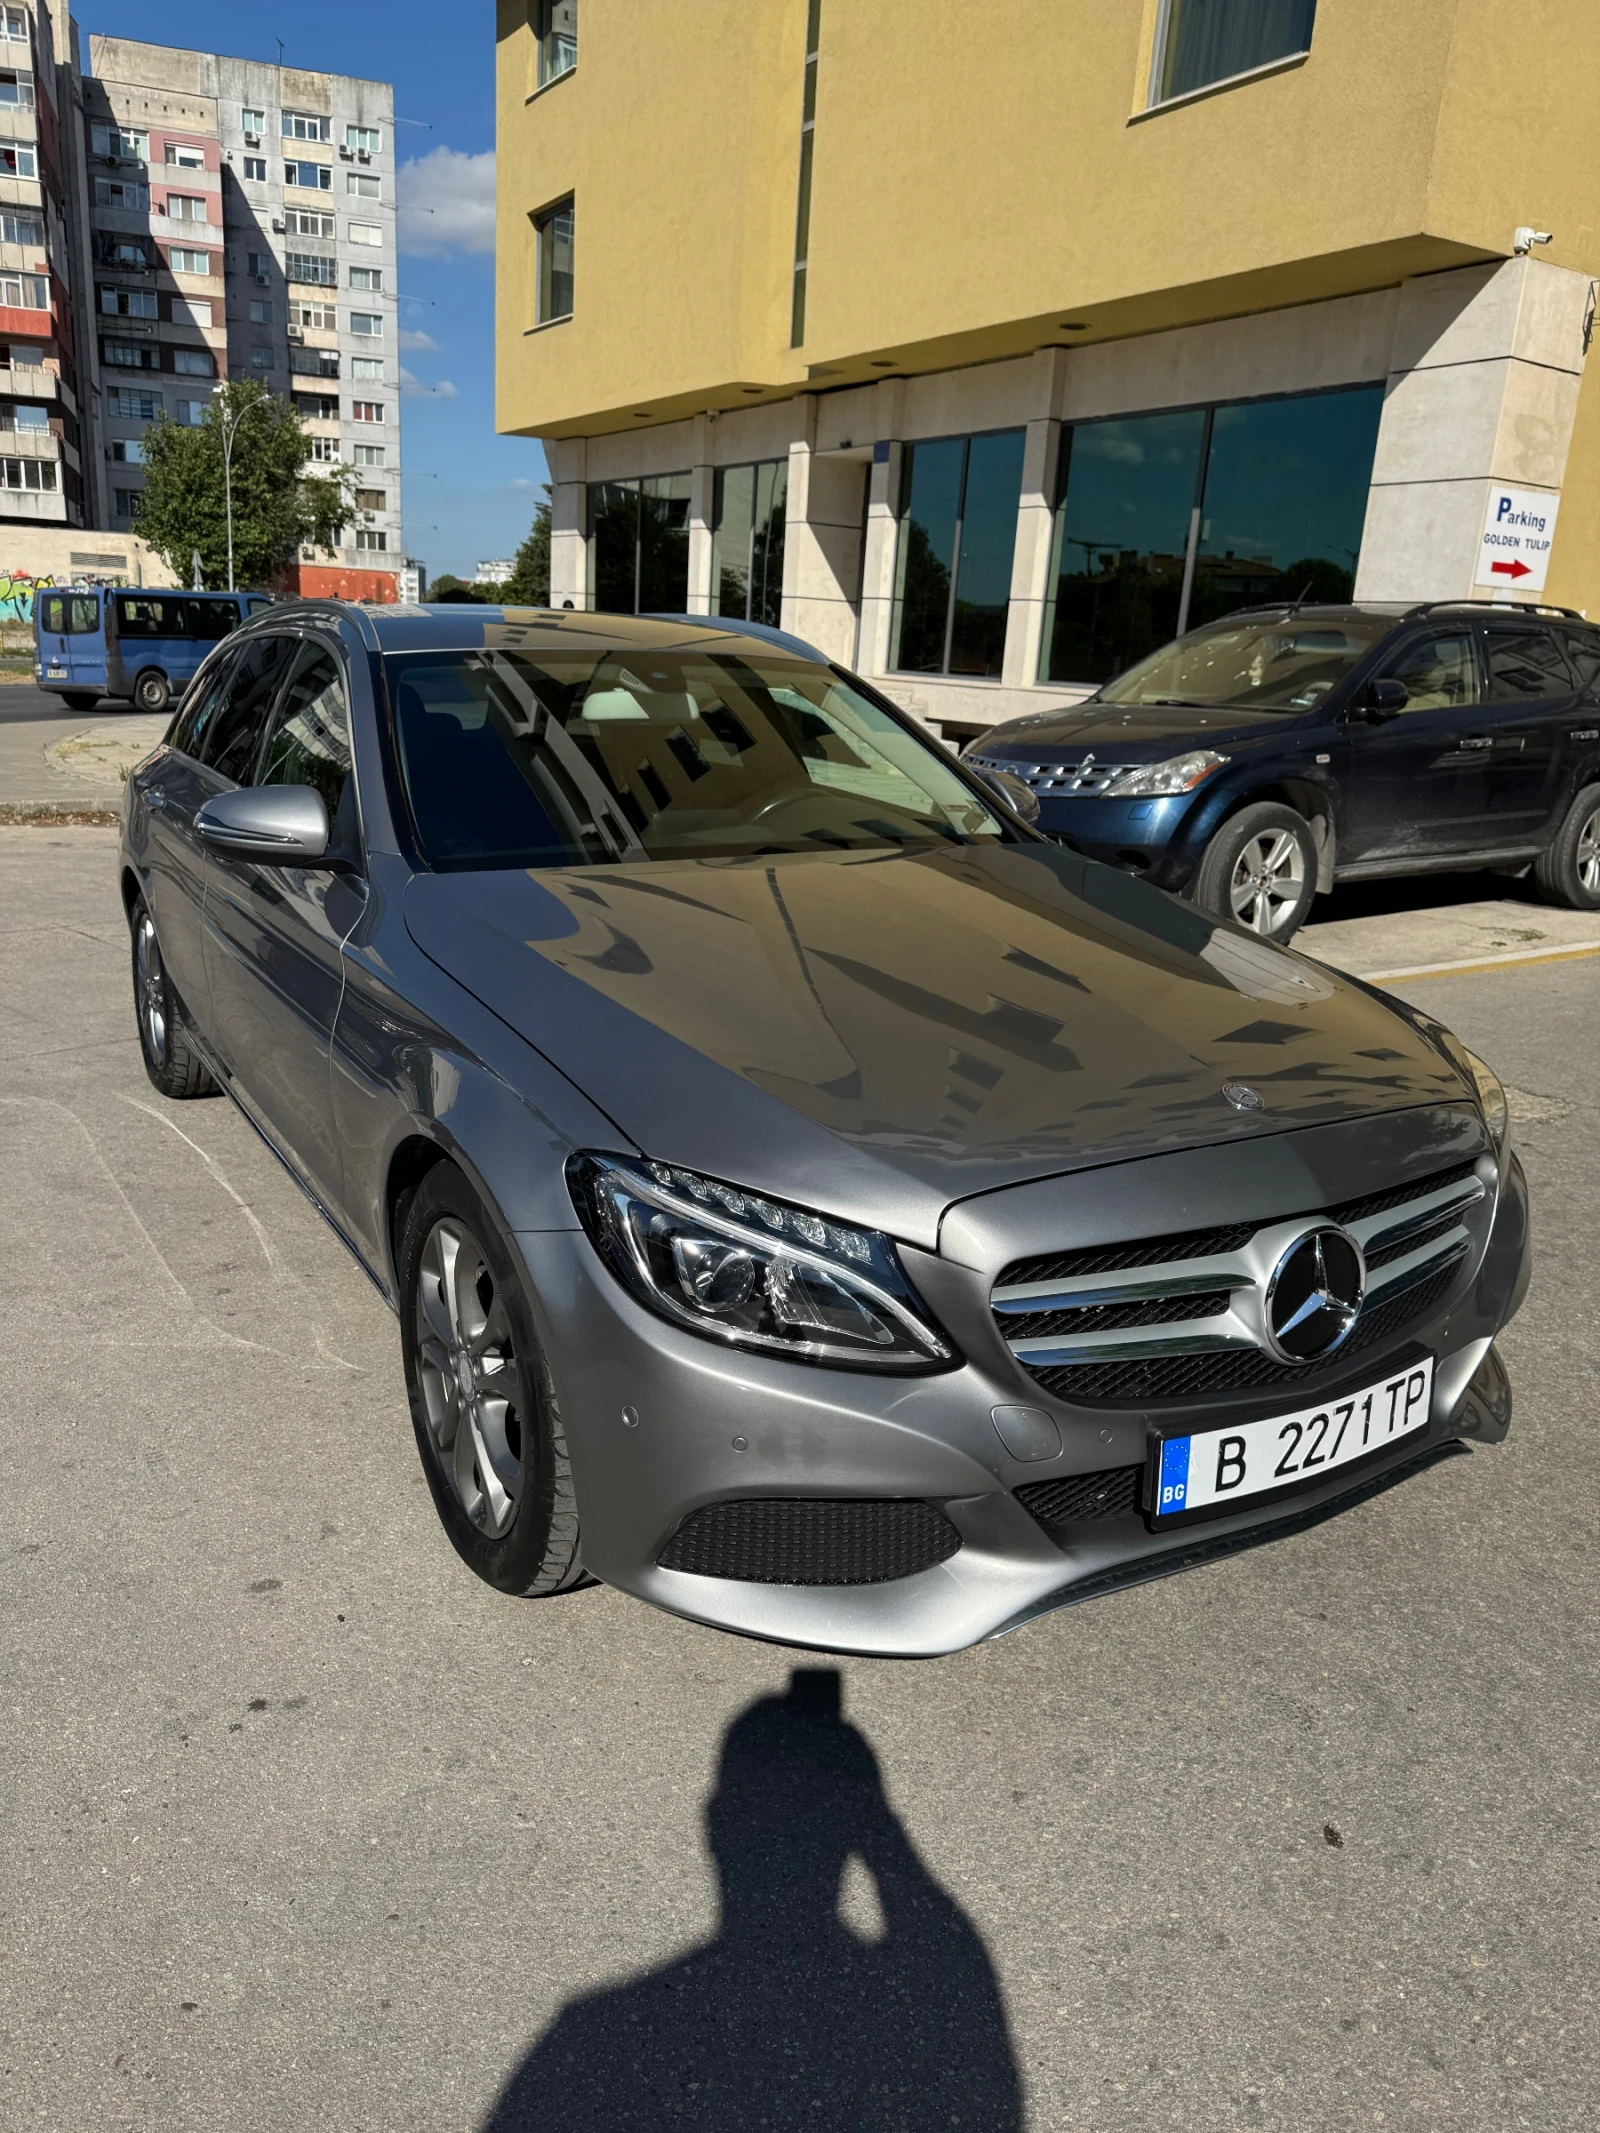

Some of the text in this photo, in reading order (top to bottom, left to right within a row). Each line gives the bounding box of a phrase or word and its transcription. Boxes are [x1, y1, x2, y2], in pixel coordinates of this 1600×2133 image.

[1496, 496, 1546, 532] Parking
[1484, 533, 1550, 551] GOLDEN TULIP
[1214, 1370, 1426, 1493] B 2271 TP
[1162, 1484, 1185, 1504] BG
